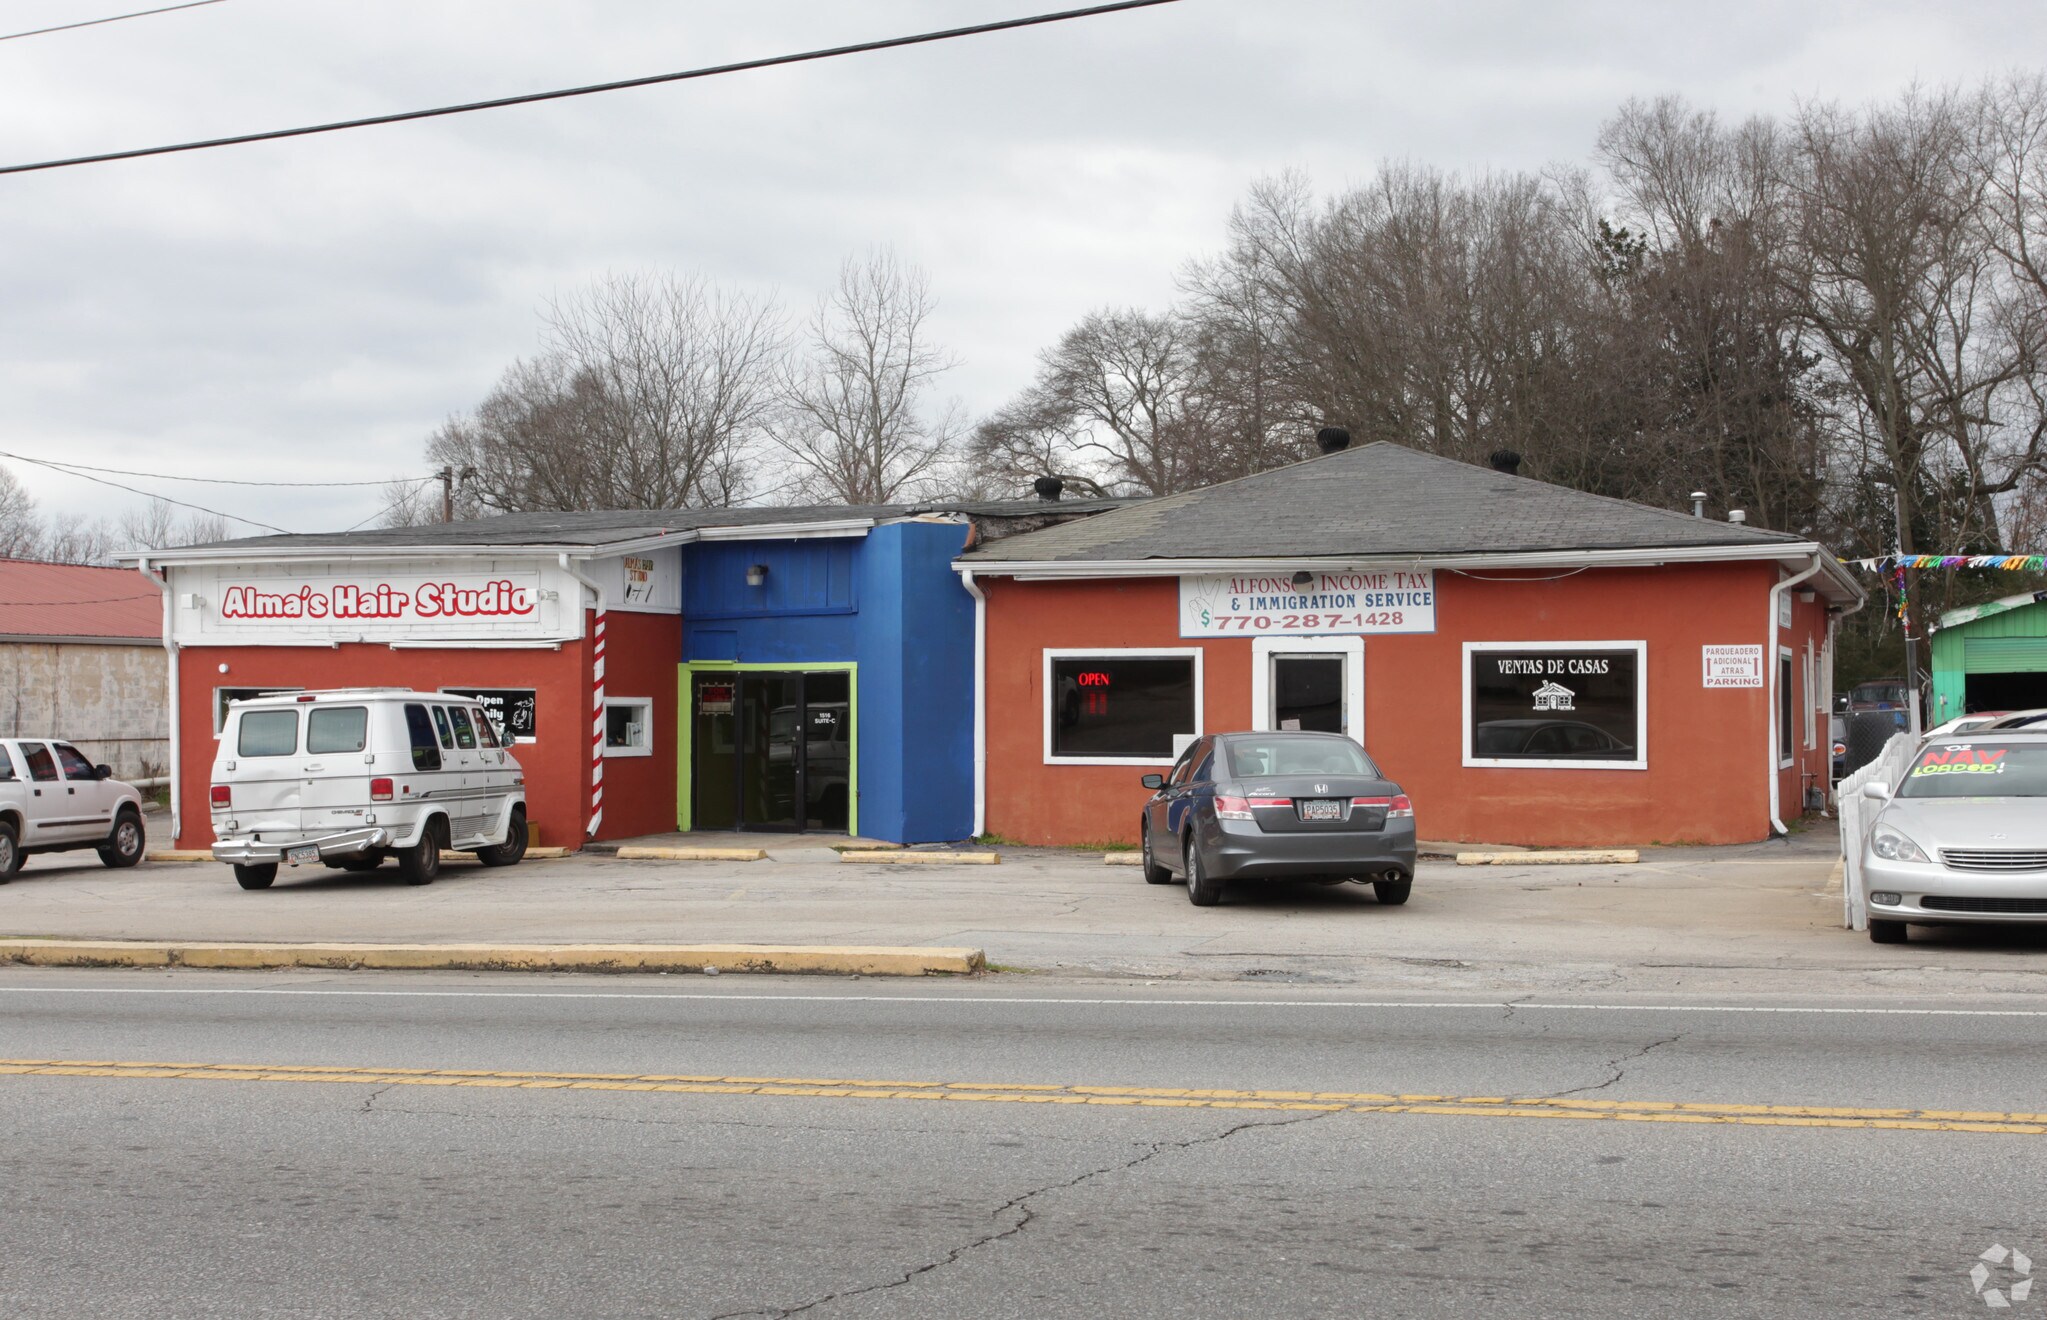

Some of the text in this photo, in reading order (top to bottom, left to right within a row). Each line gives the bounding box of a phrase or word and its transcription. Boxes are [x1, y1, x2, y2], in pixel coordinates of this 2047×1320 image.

[1228, 572, 1428, 594] ALFONS INCOME TAX
[222, 580, 535, 618] Alma's Hair Studio
[1231, 592, 1432, 611] & IMMIGRATION SERVICE
[1214, 611, 1404, 630] 770-287-1428
[1498, 659, 1609, 674] VENTAS DE CASAS
[1713, 657, 1752, 665] ADICIONAL
[1721, 667, 1745, 675] ATRAS
[1078, 672, 1110, 686] OPEN
[1707, 678, 1760, 686] PARKING
[476, 695, 504, 708] Open
[1922, 749, 2010, 766] NAV
